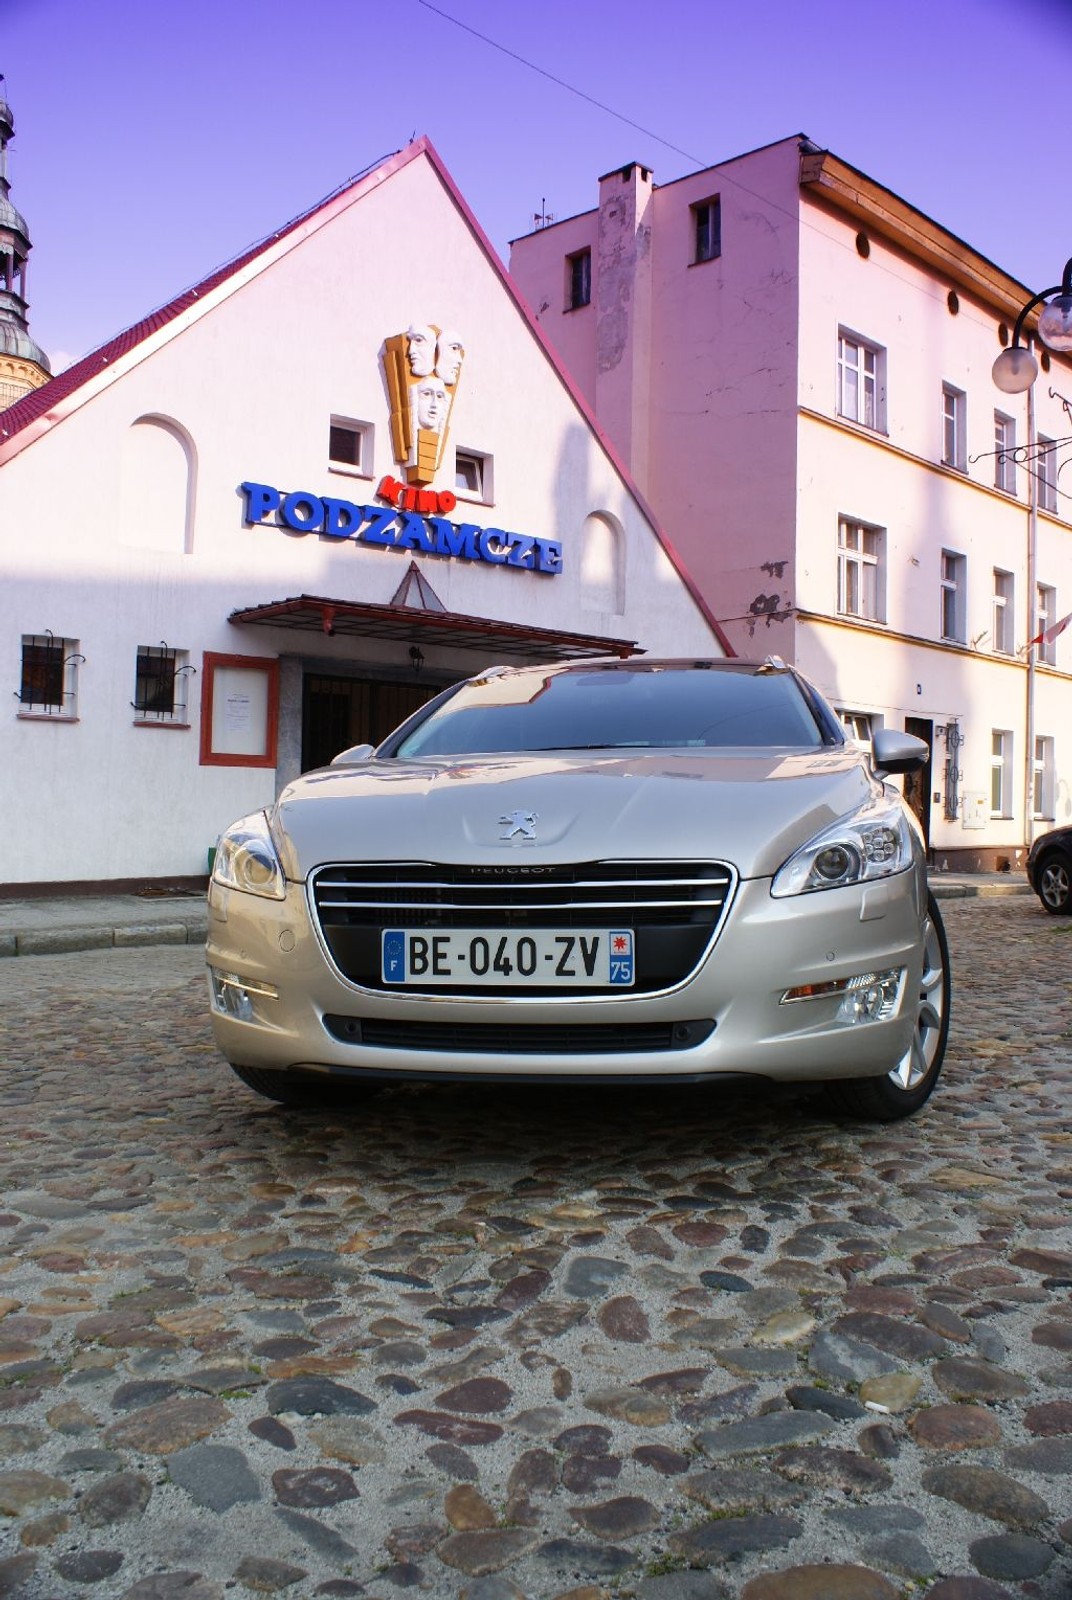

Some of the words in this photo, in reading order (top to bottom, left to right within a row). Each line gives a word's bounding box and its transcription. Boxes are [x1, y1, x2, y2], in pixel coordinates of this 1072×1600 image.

[376, 474, 456, 513] KINO
[241, 481, 563, 575] PODZAMCZE
[391, 960, 398, 971] F
[410, 936, 600, 976] BE-040-ZV
[611, 961, 630, 980] 75
